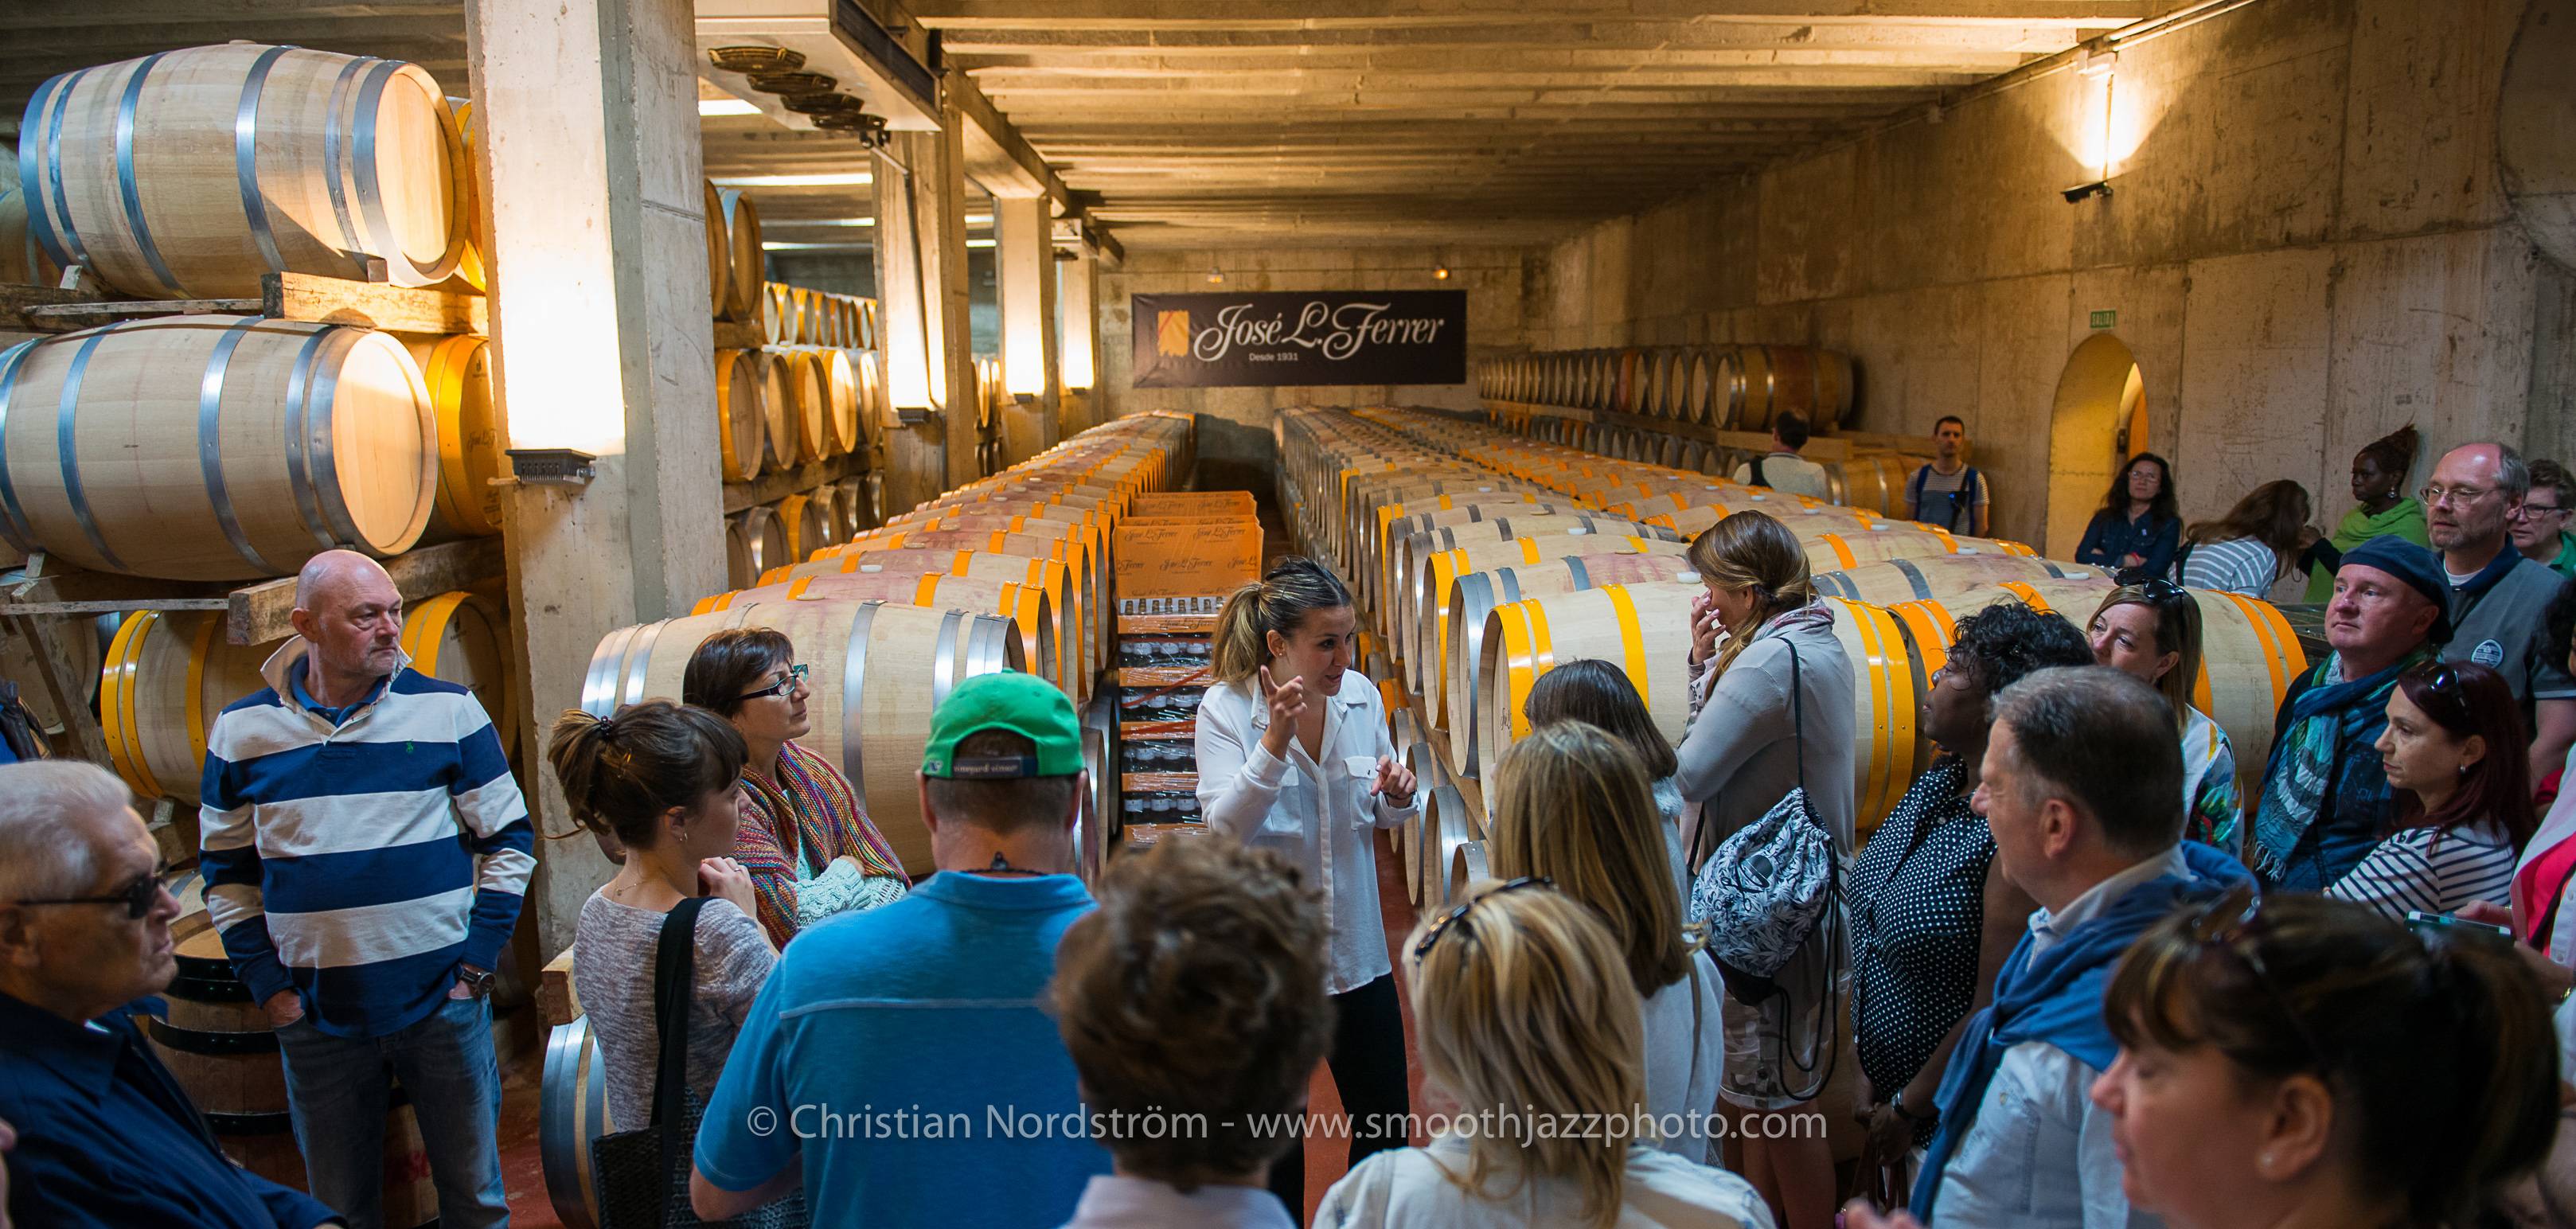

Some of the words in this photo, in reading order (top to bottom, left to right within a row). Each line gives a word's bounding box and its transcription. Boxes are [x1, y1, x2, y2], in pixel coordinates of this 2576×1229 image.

[1194, 303, 1282, 361] José
[1281, 301, 1329, 349] L.
[1322, 302, 1444, 361] Ferrer
[1249, 353, 1274, 361] Desde
[1277, 352, 1298, 361] 1931
[953, 763, 989, 776] vineyard
